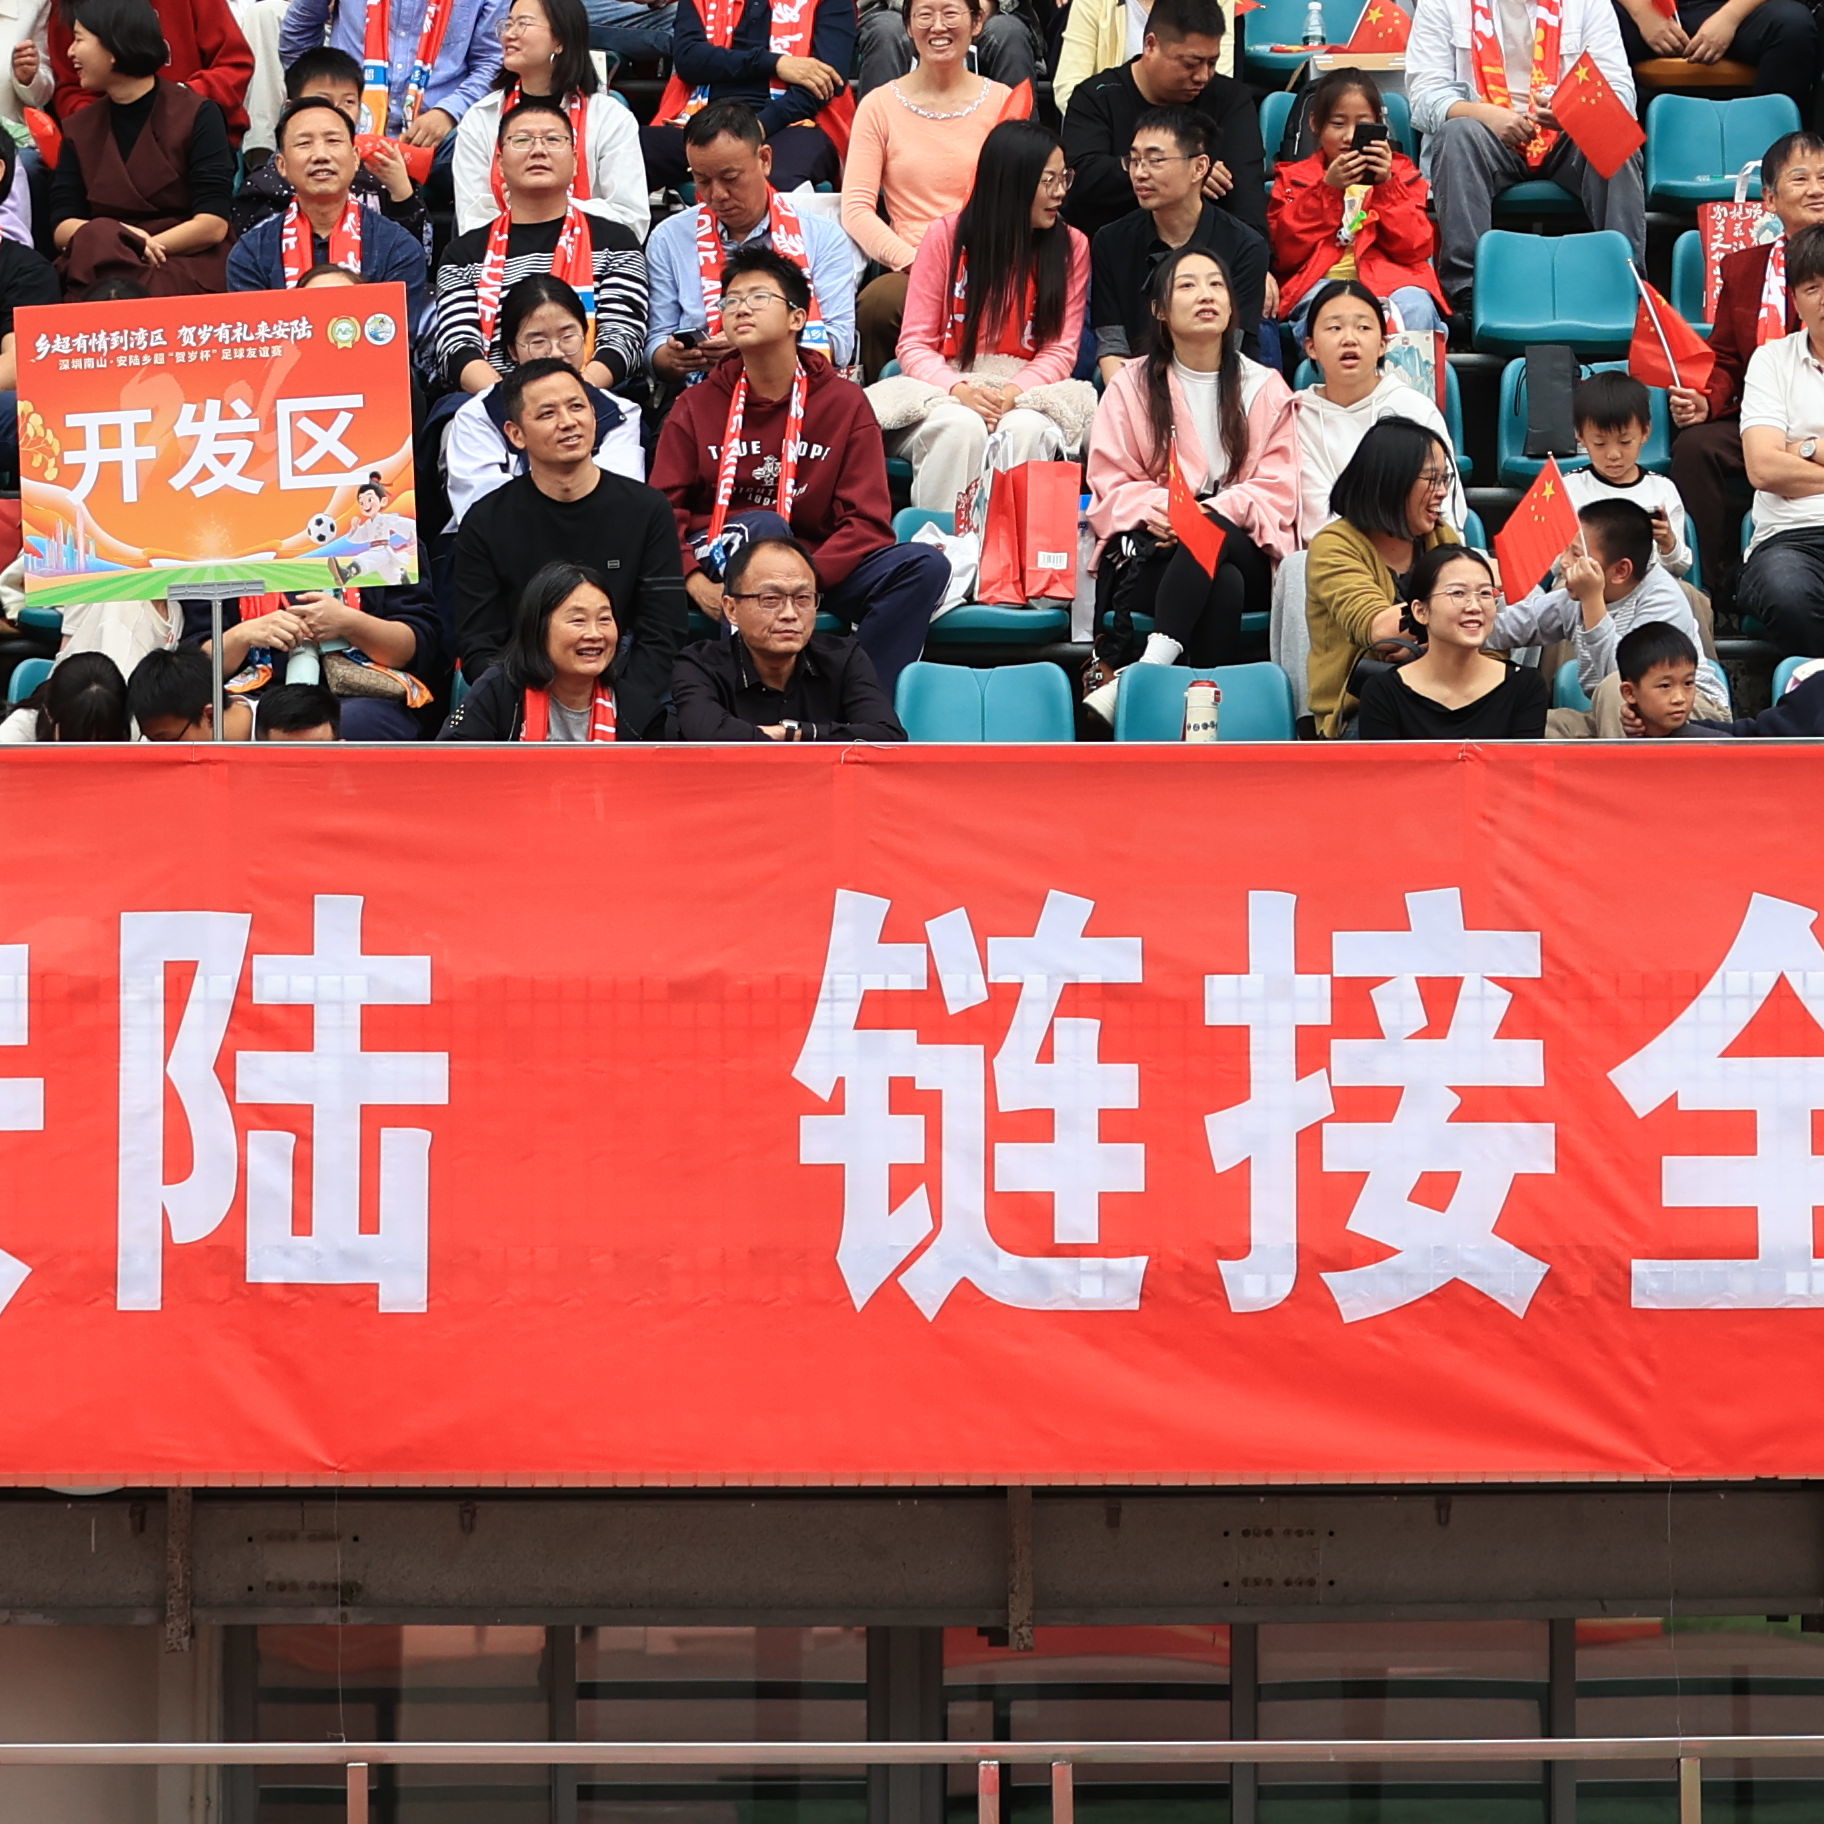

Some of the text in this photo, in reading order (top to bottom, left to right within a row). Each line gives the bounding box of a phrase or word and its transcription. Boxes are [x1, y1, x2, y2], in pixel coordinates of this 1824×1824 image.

[30, 316, 313, 363] 乡超有情到湾区 贺岁有礼来安陆
[63, 394, 371, 506] 开发区
[707, 439, 761, 460] TUE
